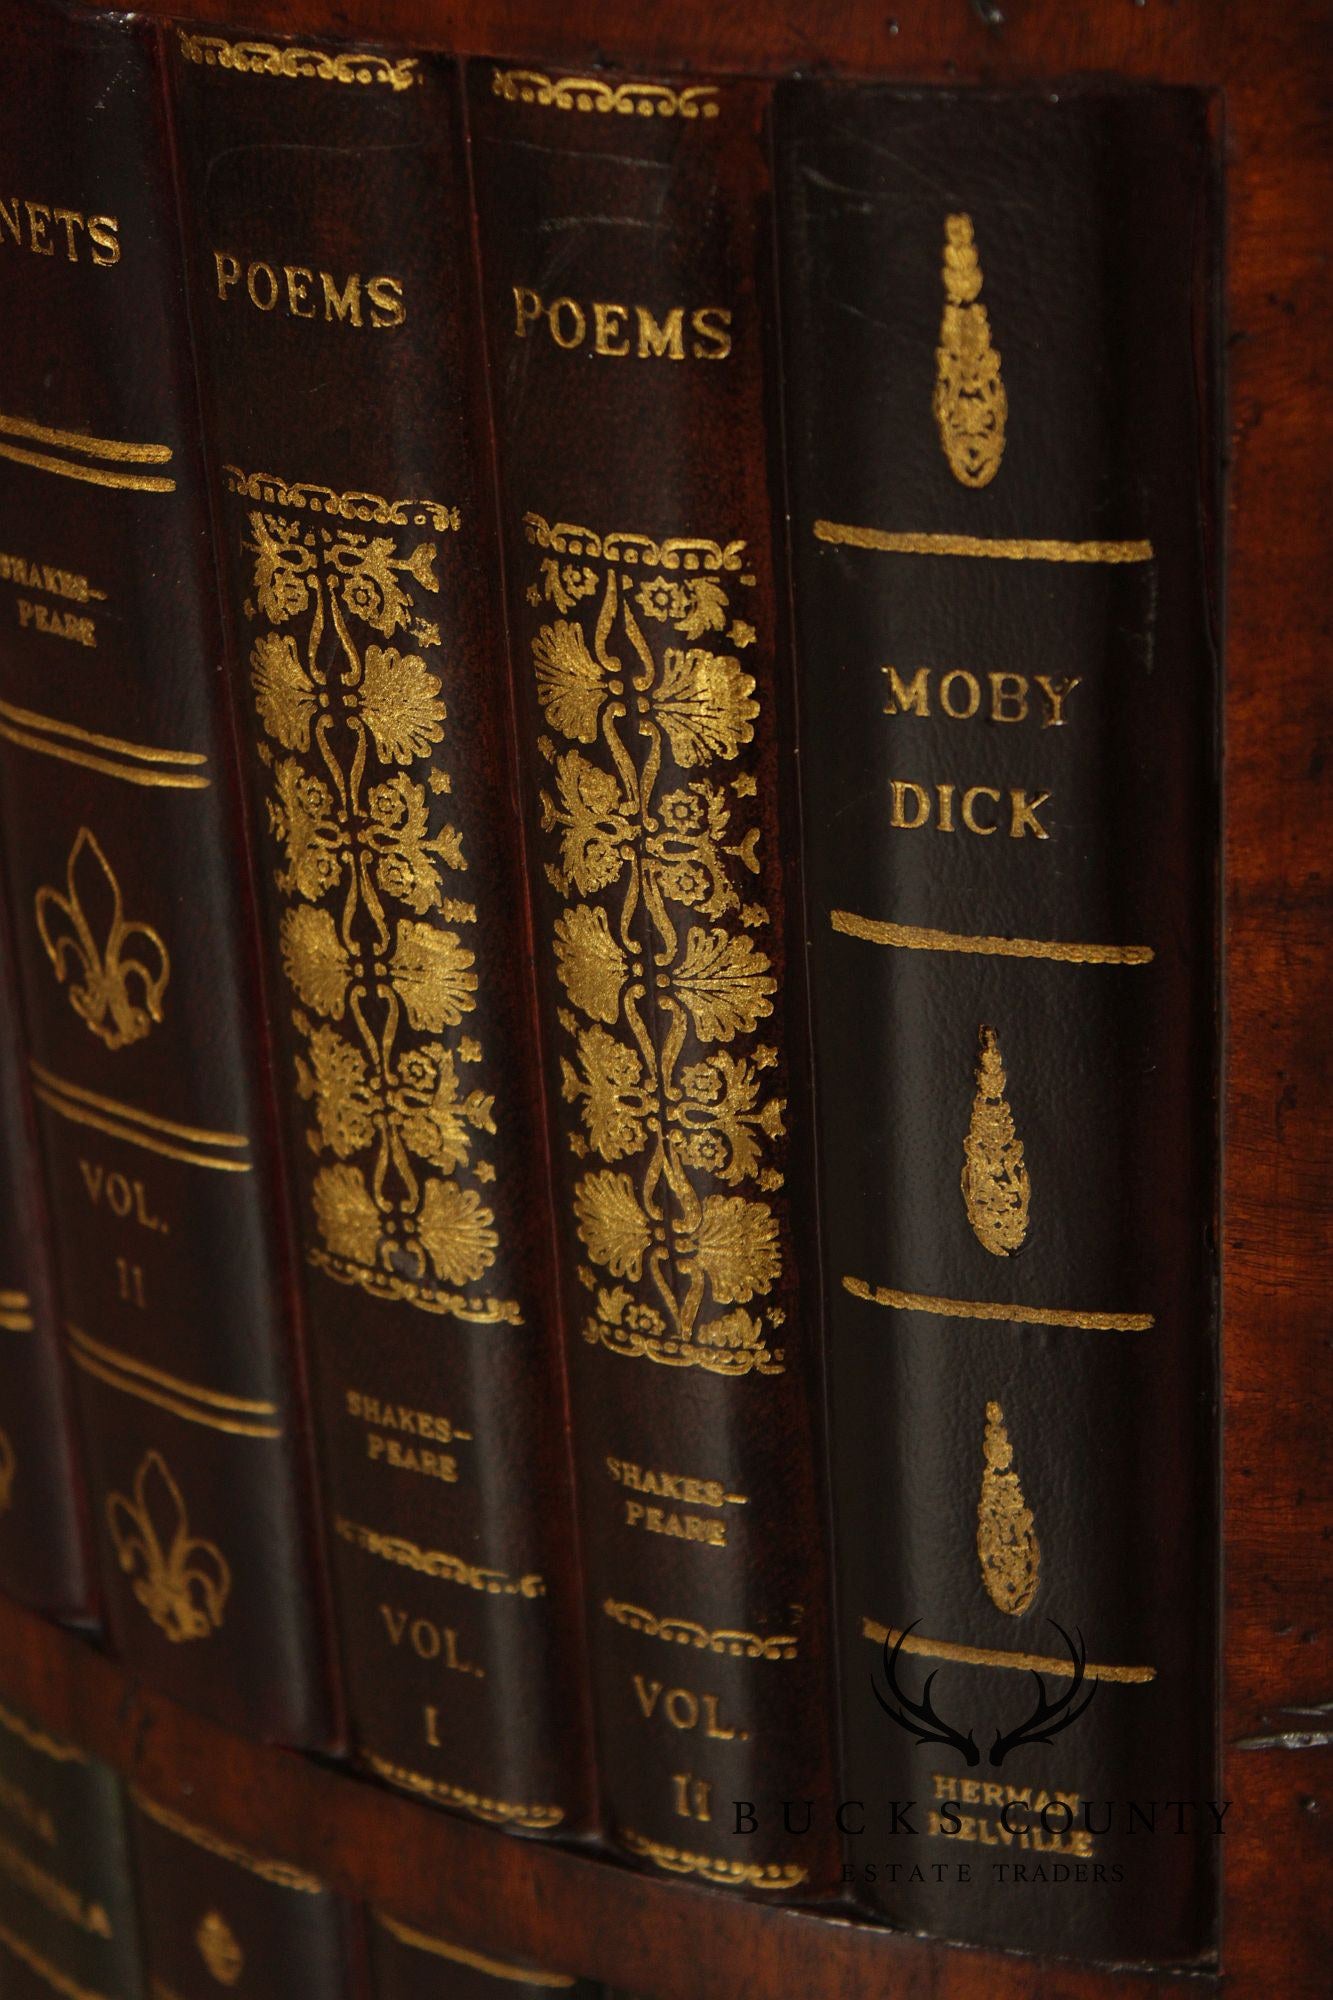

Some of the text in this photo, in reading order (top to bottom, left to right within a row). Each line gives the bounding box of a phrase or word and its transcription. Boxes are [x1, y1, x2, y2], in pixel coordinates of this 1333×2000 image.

[213, 249, 406, 328] POEMS
[511, 285, 733, 360] POEMS
[17, 599, 97, 648] PEARE
[880, 665, 1082, 728] MOBY
[890, 779, 1052, 840] DICK
[79, 1156, 170, 1234] VOL.
[345, 1390, 473, 1443] SHAKES-
[367, 1432, 458, 1483] PEARE
[605, 1456, 748, 1507] SHAKES-
[626, 1500, 728, 1547] PEARE
[380, 1604, 486, 1678] VOL.
[634, 1674, 750, 1741] VOL.
[932, 1774, 1080, 1817] HERMAN
[927, 1809, 1094, 1858] MELVILLE
